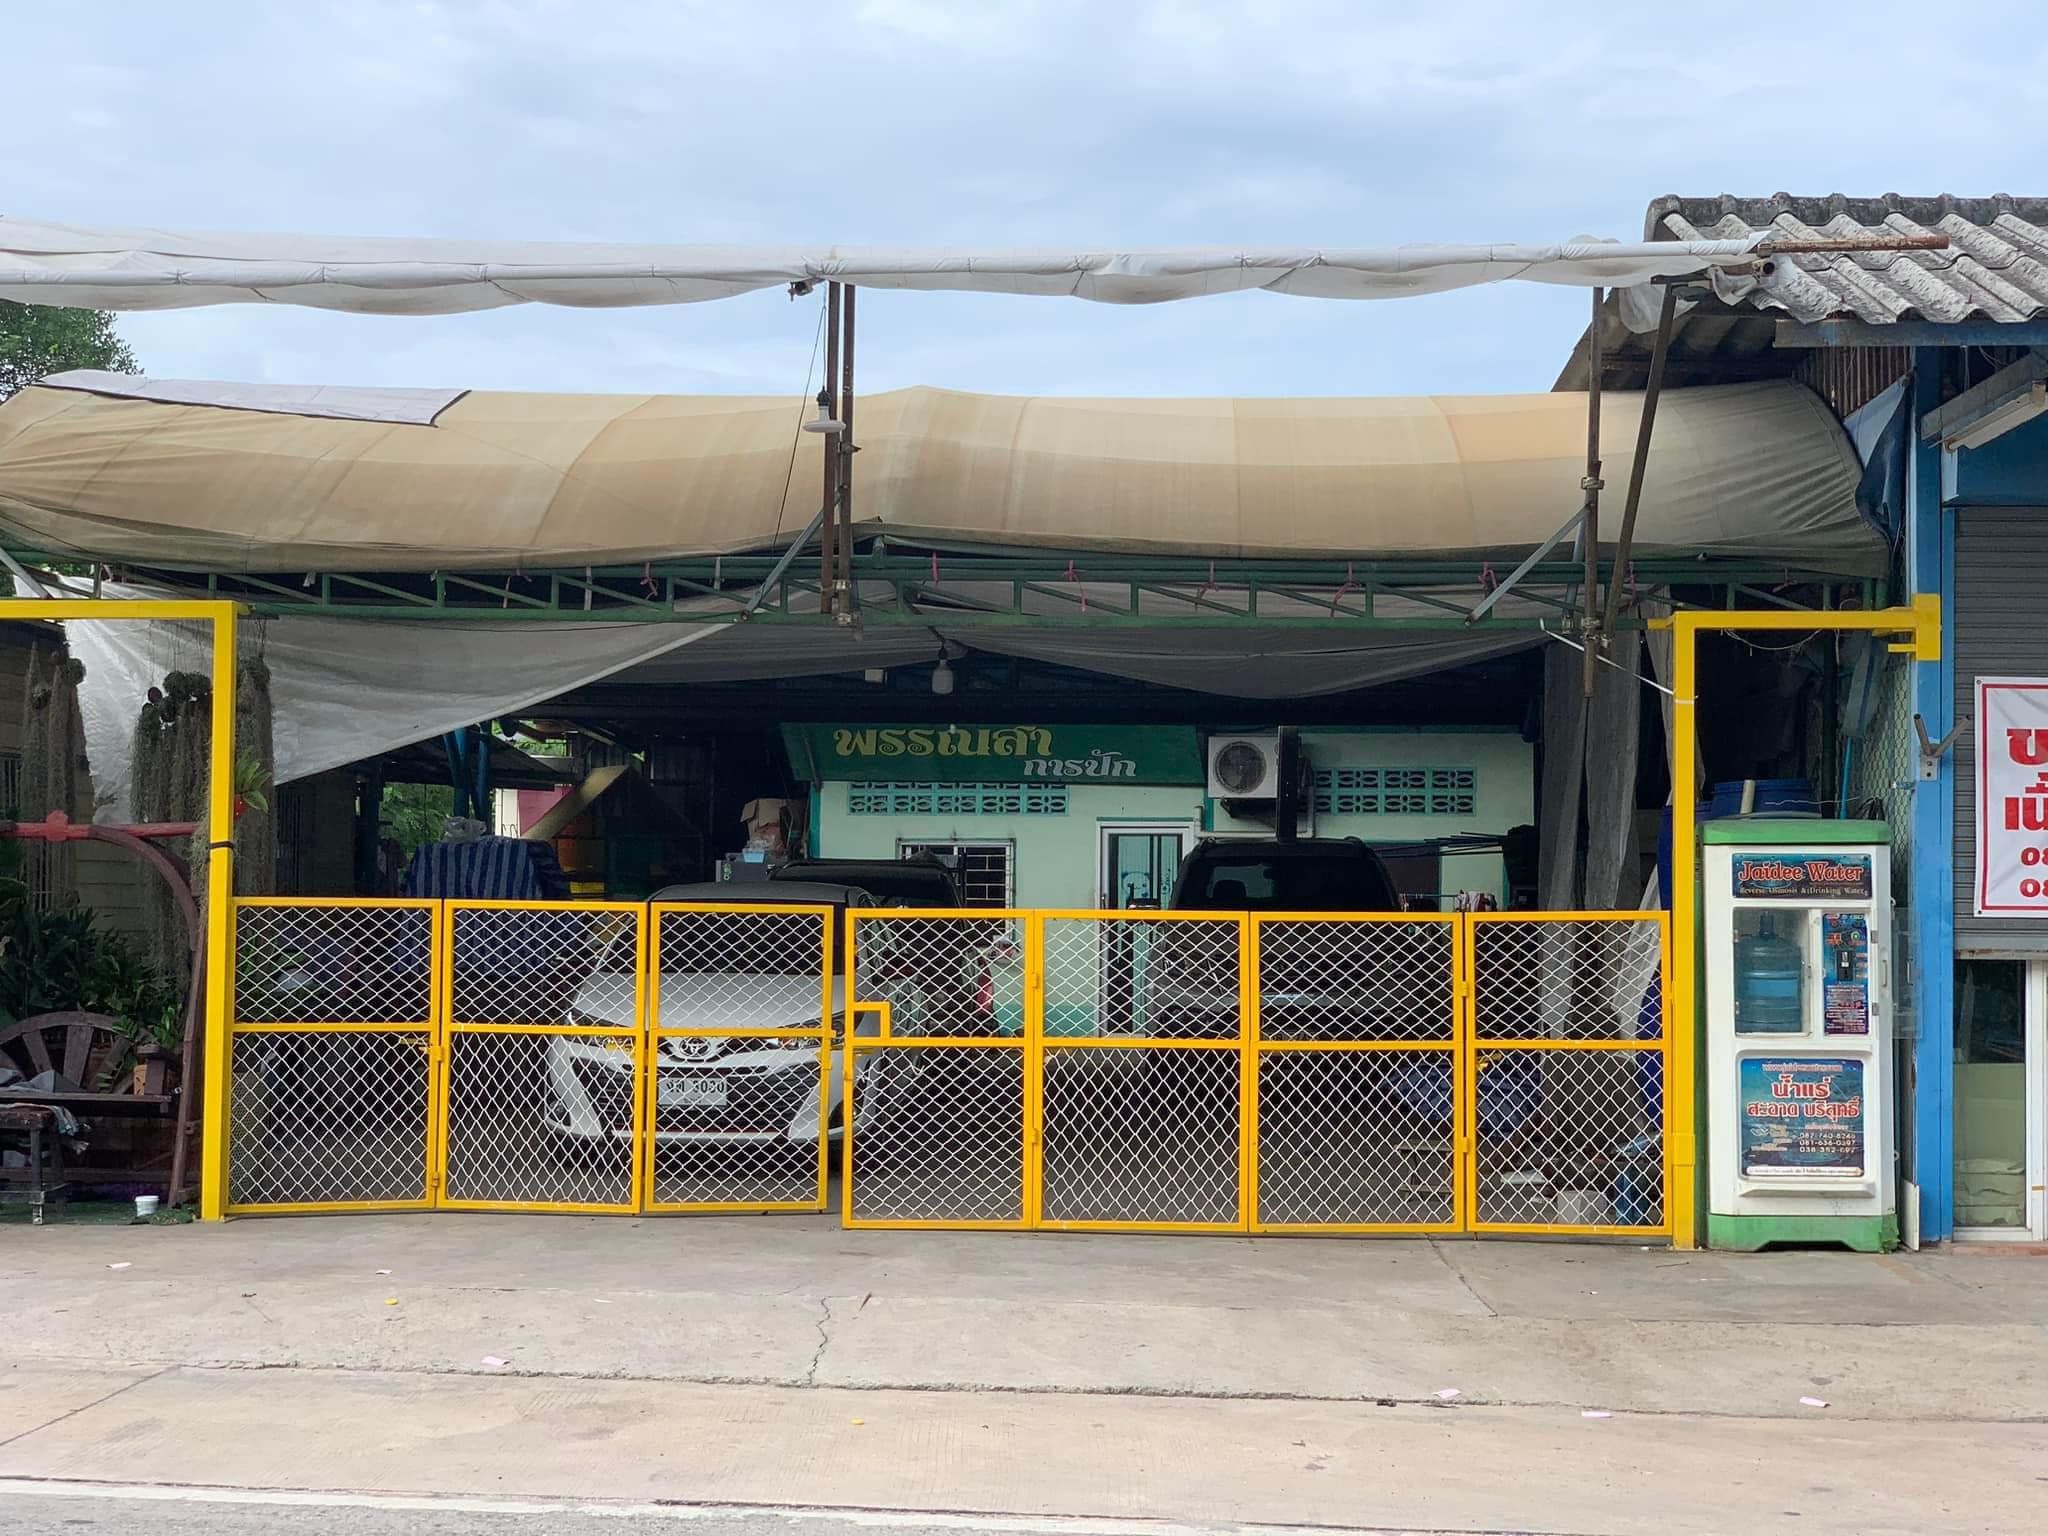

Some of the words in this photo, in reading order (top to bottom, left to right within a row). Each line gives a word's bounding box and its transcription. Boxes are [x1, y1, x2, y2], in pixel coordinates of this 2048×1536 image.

[1738, 861, 1802, 881] Jaidee
[1805, 861, 1864, 881] Water
[1772, 1074, 1831, 1098] น้ำแร่
[1747, 1102, 1799, 1116] สะอาด
